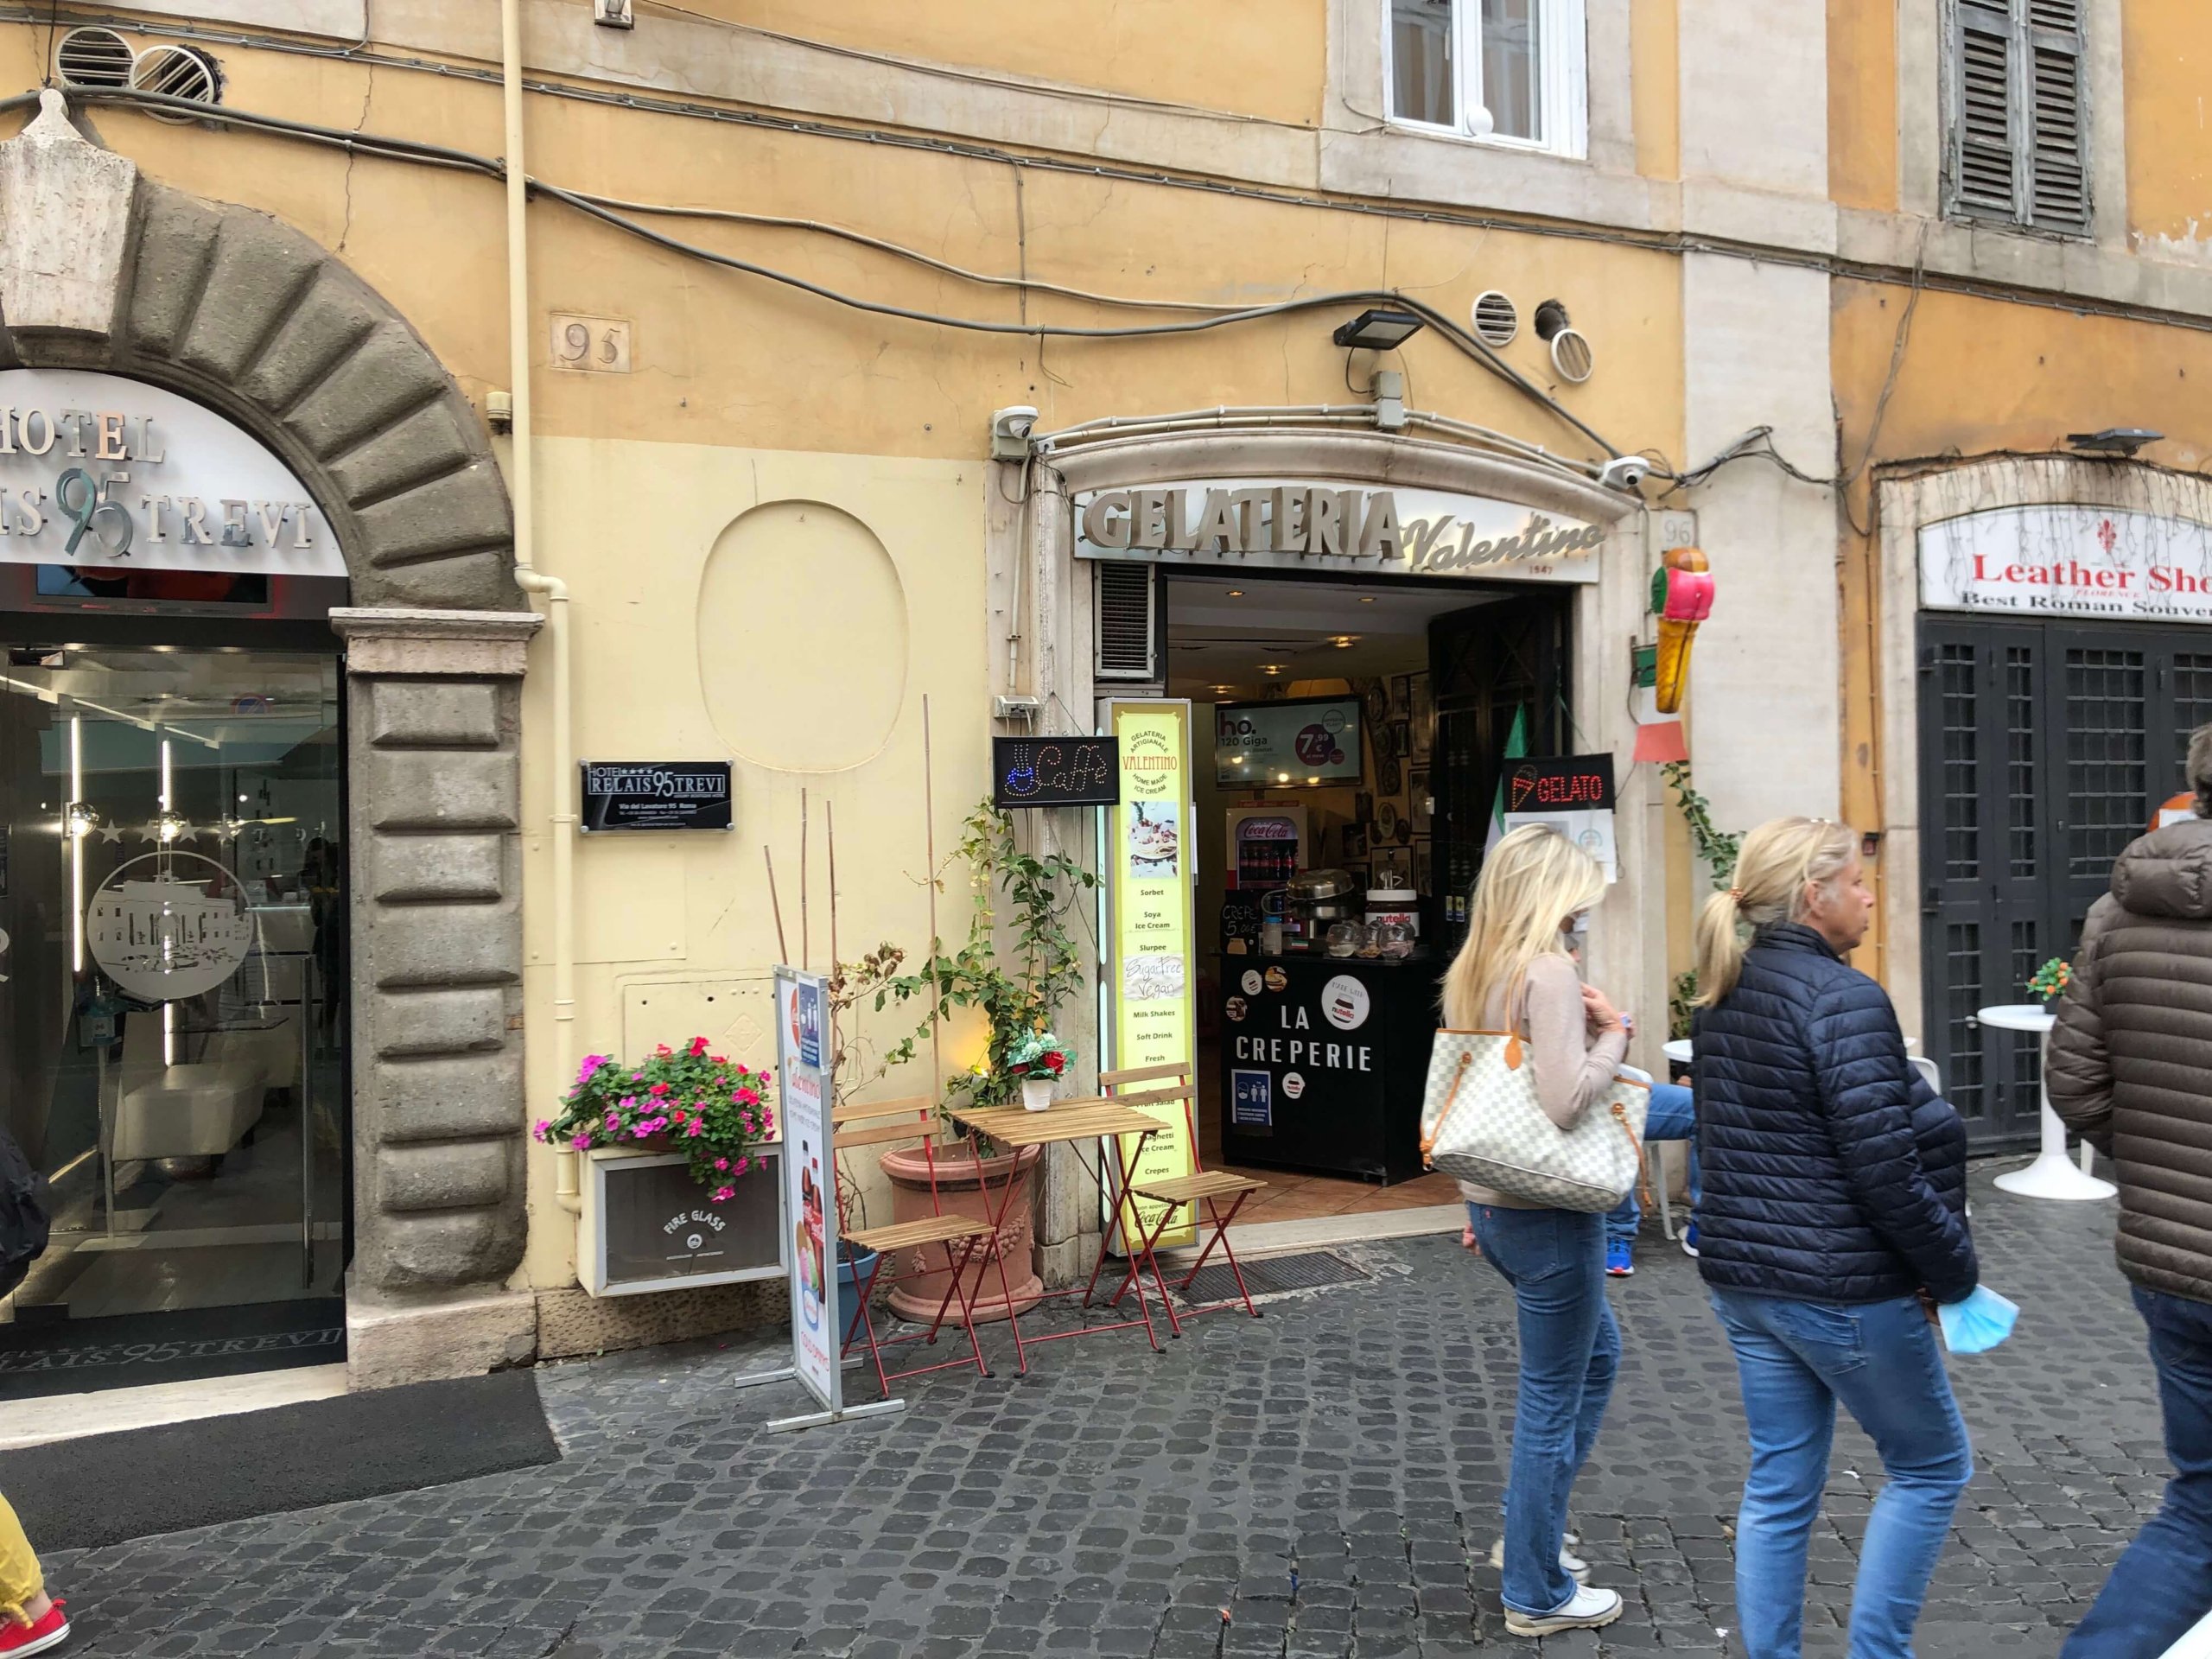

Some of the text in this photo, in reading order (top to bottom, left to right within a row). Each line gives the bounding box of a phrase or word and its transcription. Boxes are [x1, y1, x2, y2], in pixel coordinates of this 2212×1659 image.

[559, 323, 621, 365] 95
[55, 467, 134, 558] 95
[140, 493, 313, 549] TREVI
[1083, 486, 1606, 571] GELATERIA Valentino
[1664, 519, 1690, 543] 96
[1972, 553, 2136, 589] Leather
[1961, 590, 2018, 607] Best
[2030, 594, 2124, 612] Roman
[1130, 730, 1166, 741] GELATERIA
[1130, 738, 1169, 753] ARTIGIANALE
[1221, 735, 1268, 747] 120 Giga
[1122, 756, 1178, 771] VALENTINO
[592, 772, 722, 798] RELAIS 95 TREVI
[1132, 772, 1168, 786] HOME MADE
[1134, 784, 1167, 795] ICE CREAM
[1536, 775, 1603, 802] GELATO
[1144, 911, 1161, 919] Soya
[1376, 912, 1411, 924] nutella
[1138, 977, 1175, 999] Vegan
[1281, 1005, 1310, 1030] LA
[1332, 1007, 1354, 1020] nutella
[1236, 1035, 1372, 1071] CREPERIE
[1140, 1132, 1174, 1142] aghetti
[663, 1210, 727, 1235] FIRE GLASS
[1135, 1208, 1180, 1228] Coca-Ca
[190, 1331, 334, 1356] TREVI
